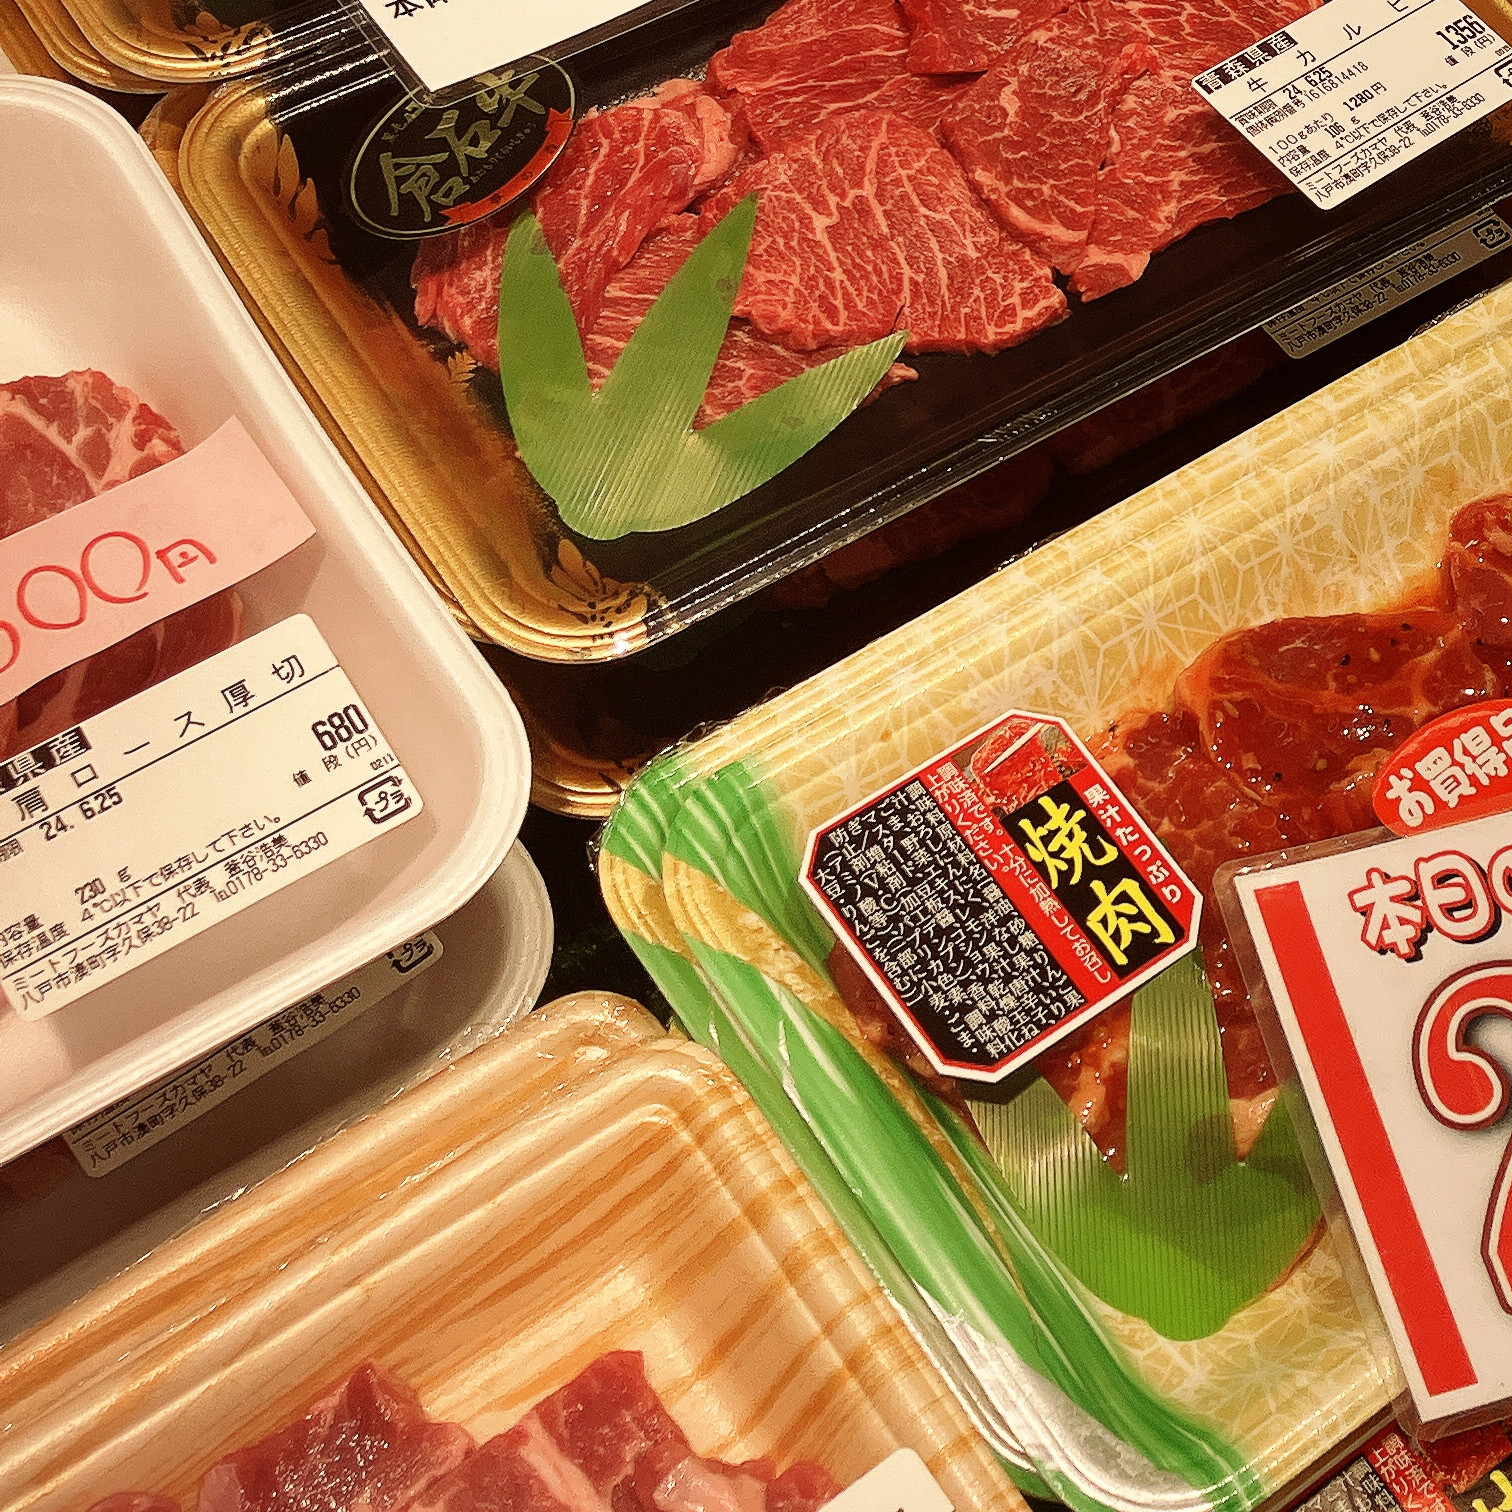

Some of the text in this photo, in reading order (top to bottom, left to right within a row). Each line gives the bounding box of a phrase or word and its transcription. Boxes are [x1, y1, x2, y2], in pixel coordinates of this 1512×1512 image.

[1436, 15, 1486, 50] 1356
[1195, 30, 1298, 95] 青森県産
[1304, 61, 1369, 102] 1616814418
[1343, 82, 1387, 111] 1280円
[1325, 122, 1345, 138] 106
[311, 704, 369, 752] 680
[1084, 787, 1182, 904] 果汁たっぷり
[75, 879, 106, 906] 230
[1018, 796, 1175, 965] 焼肉
